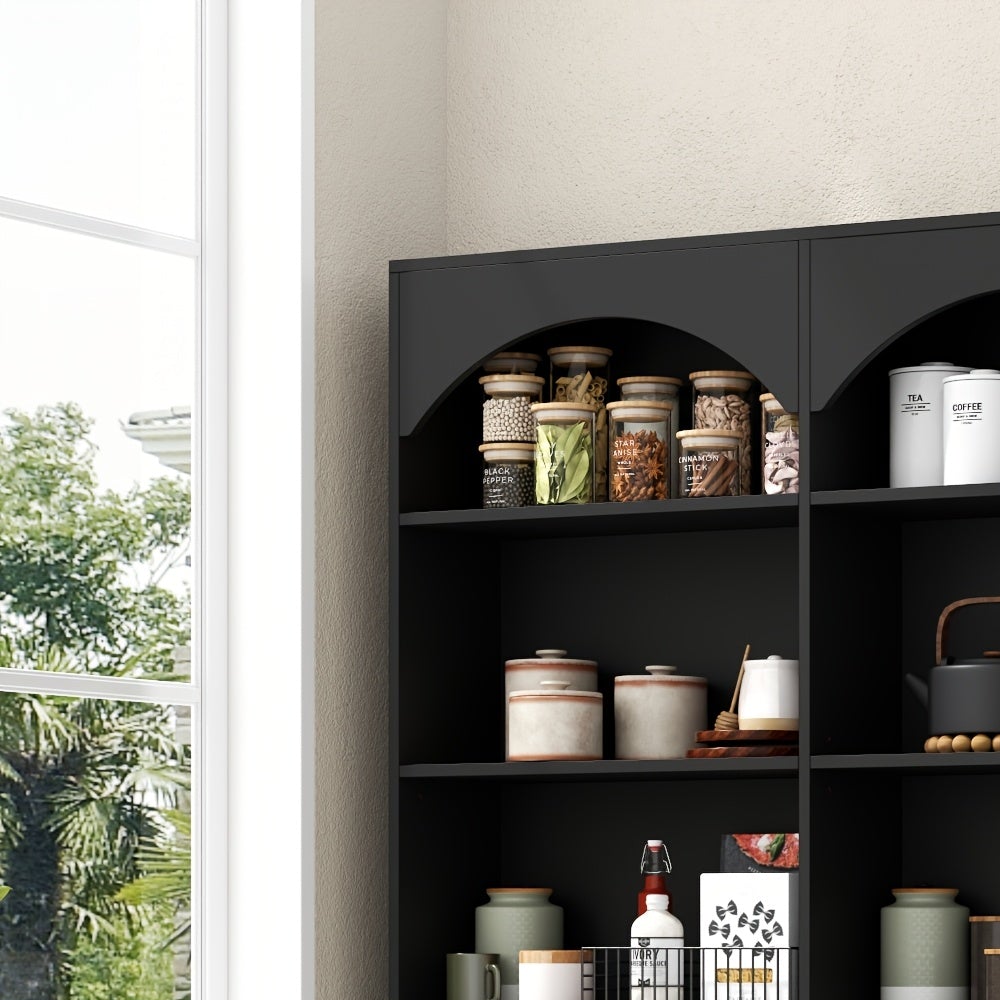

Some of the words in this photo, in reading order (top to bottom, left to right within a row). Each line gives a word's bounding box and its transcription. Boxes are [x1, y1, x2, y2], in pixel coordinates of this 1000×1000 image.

[907, 394, 923, 402] TEA
[952, 402, 982, 412] COFFEE
[614, 439, 635, 448] STAR
[613, 449, 638, 457] ANISE
[484, 467, 510, 476] BLACK
[683, 464, 708, 472] STICK
[483, 476, 514, 485] PEPPER
[632, 948, 660, 960] IVORY
